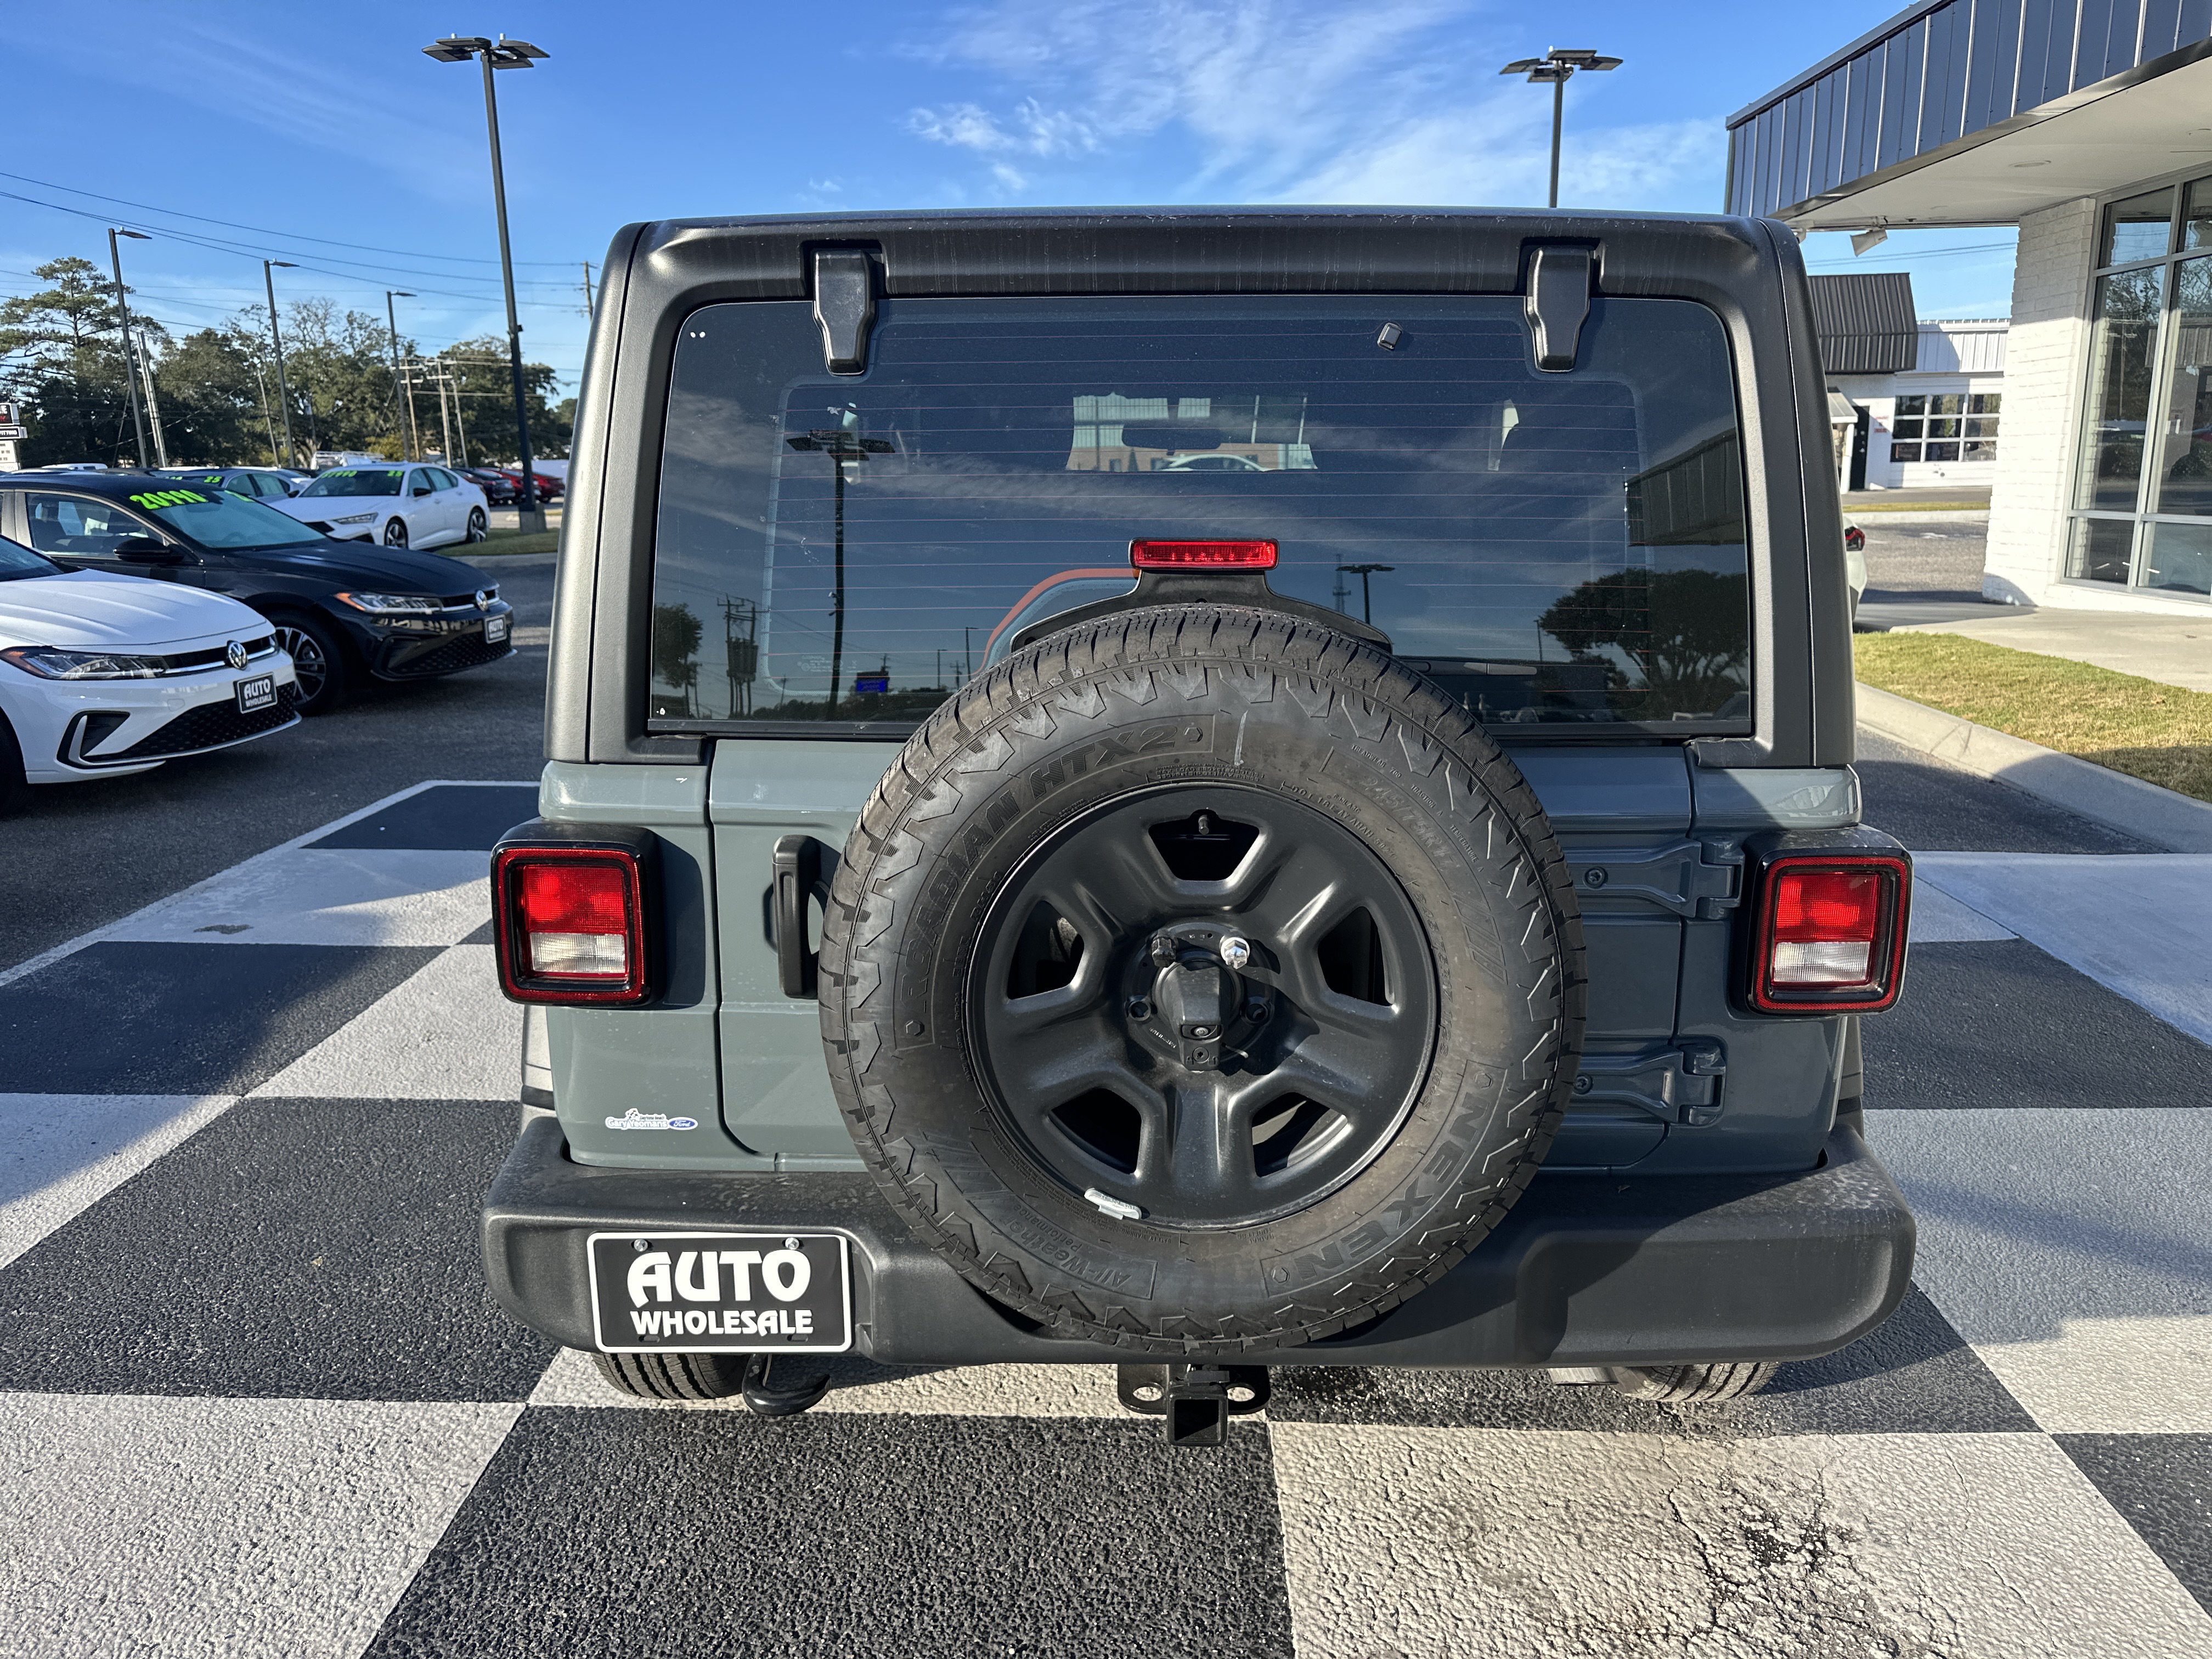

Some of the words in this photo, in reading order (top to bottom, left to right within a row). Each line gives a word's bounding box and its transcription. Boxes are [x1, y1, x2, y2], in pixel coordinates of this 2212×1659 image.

[129, 489, 209, 510] 20990
[244, 679, 270, 699] AUTO
[1352, 744, 1386, 768] TREADWEAR
[1290, 784, 1313, 800] DOT
[1410, 785, 1437, 809] TRACTION
[1449, 825, 1479, 863] TEMPERATURE
[900, 789, 1020, 1014] ROADIAN
[1029, 724, 1178, 799] HTX2
[607, 1119, 627, 1128] Gary
[628, 1119, 668, 1128] Yeomans
[673, 1120, 691, 1128] Ford
[1293, 1092, 1491, 1282] NEXEN
[1014, 1204, 1082, 1252] Performance
[1003, 1217, 1132, 1288] All-Weather
[627, 1249, 811, 1308] AUTO
[630, 1309, 814, 1338] WHOLESALE
